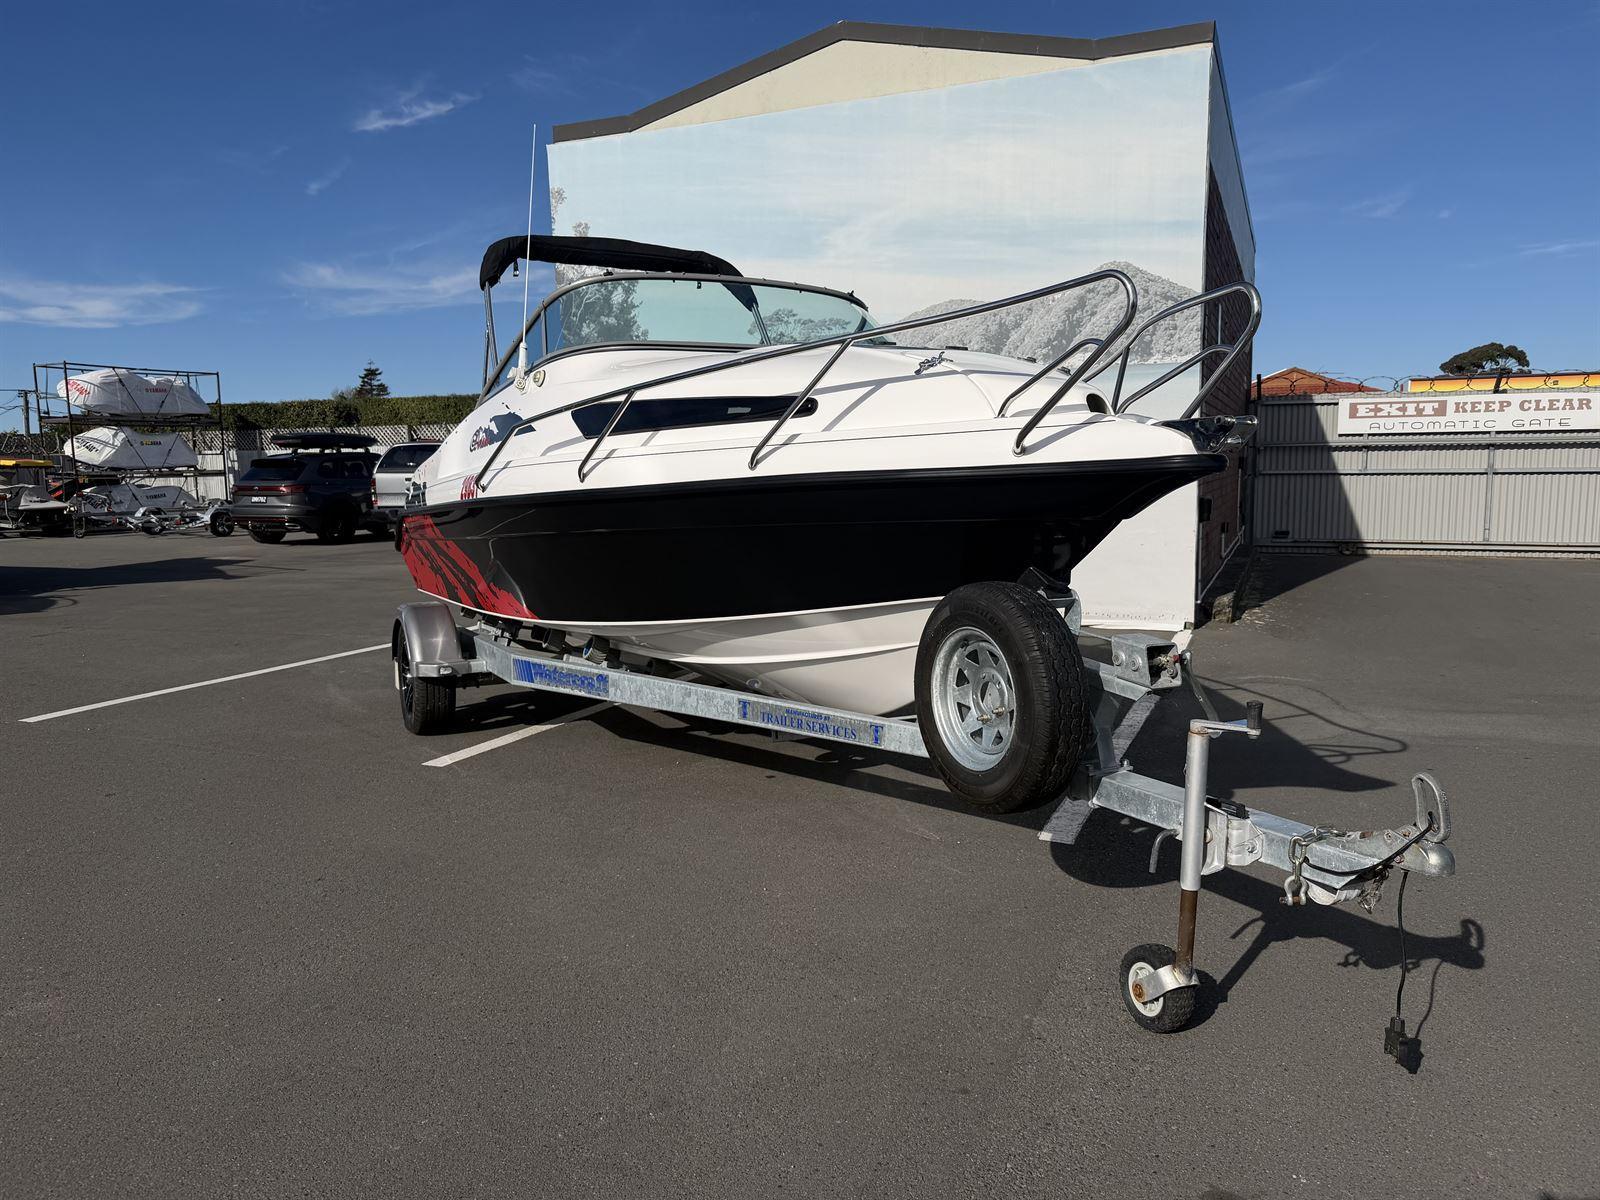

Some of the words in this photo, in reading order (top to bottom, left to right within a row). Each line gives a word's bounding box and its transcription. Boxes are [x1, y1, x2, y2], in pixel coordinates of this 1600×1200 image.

[1356, 402, 1439, 417] EXIT
[1453, 400, 1512, 414] KEEP
[1518, 398, 1593, 412] CLEAR
[1369, 419, 1497, 431] AUTOMATIC
[1511, 417, 1571, 428] GATE
[760, 711, 804, 730] TRAILER
[805, 719, 857, 740] SERVICES
